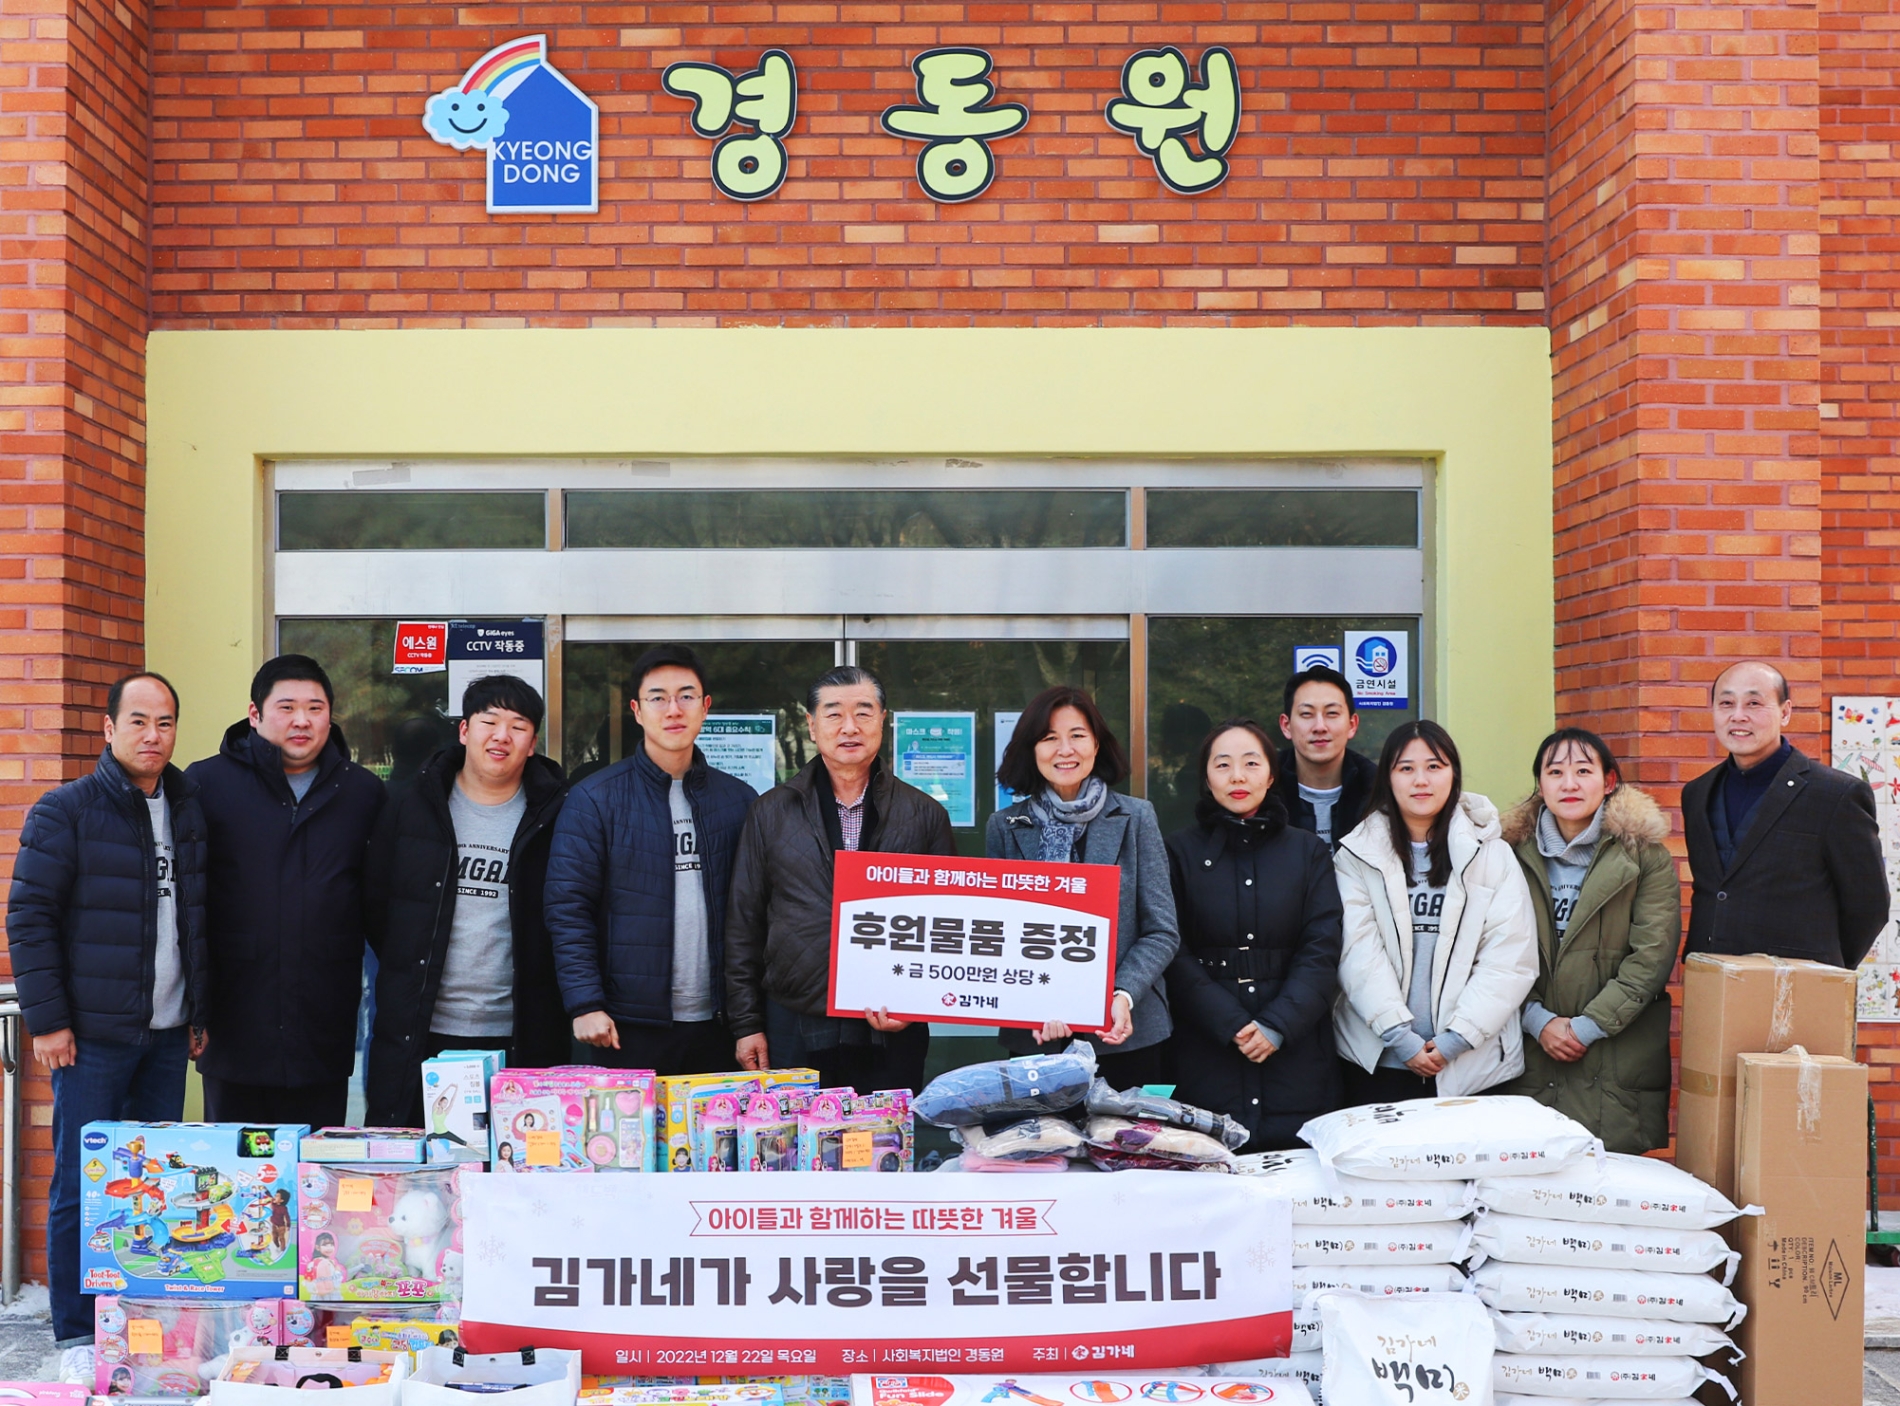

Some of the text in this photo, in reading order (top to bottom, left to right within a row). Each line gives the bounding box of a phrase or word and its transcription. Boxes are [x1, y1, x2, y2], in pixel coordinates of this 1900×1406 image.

[662, 46, 1242, 204] 경동원
[493, 140, 592, 162] KYEONG
[503, 163, 581, 184] DONG
[402, 636, 437, 650] 에스원
[466, 640, 525, 652] CCTV 작동중
[1356, 679, 1396, 689] 금연시설
[469, 843, 510, 854] ANNIVERSARY
[866, 865, 1087, 894] 아이들과 함께하는 따뜻한 겨울
[850, 911, 1097, 962] 후원물품 증정
[909, 963, 1034, 985] 금 500만원 상당
[959, 994, 998, 1009] 김가네
[708, 1207, 1037, 1231] 아이들과 함께하는 따뜻한 겨울
[90, 1269, 120, 1278] Toot-Toot
[532, 1251, 1221, 1307] 김가네가 사랑을 선물합니다
[1833, 1272, 1842, 1287] ML
[85, 1278, 112, 1288] Drivers
[616, 1349, 816, 1363] 일시 2022년 12월 22일 목요일
[842, 1348, 1004, 1363] 장소 사회복지법인 경동원
[1033, 1345, 1135, 1361] 주최 김가네
[1377, 1334, 1436, 1363] 김가네
[1371, 1357, 1455, 1403] 백미
